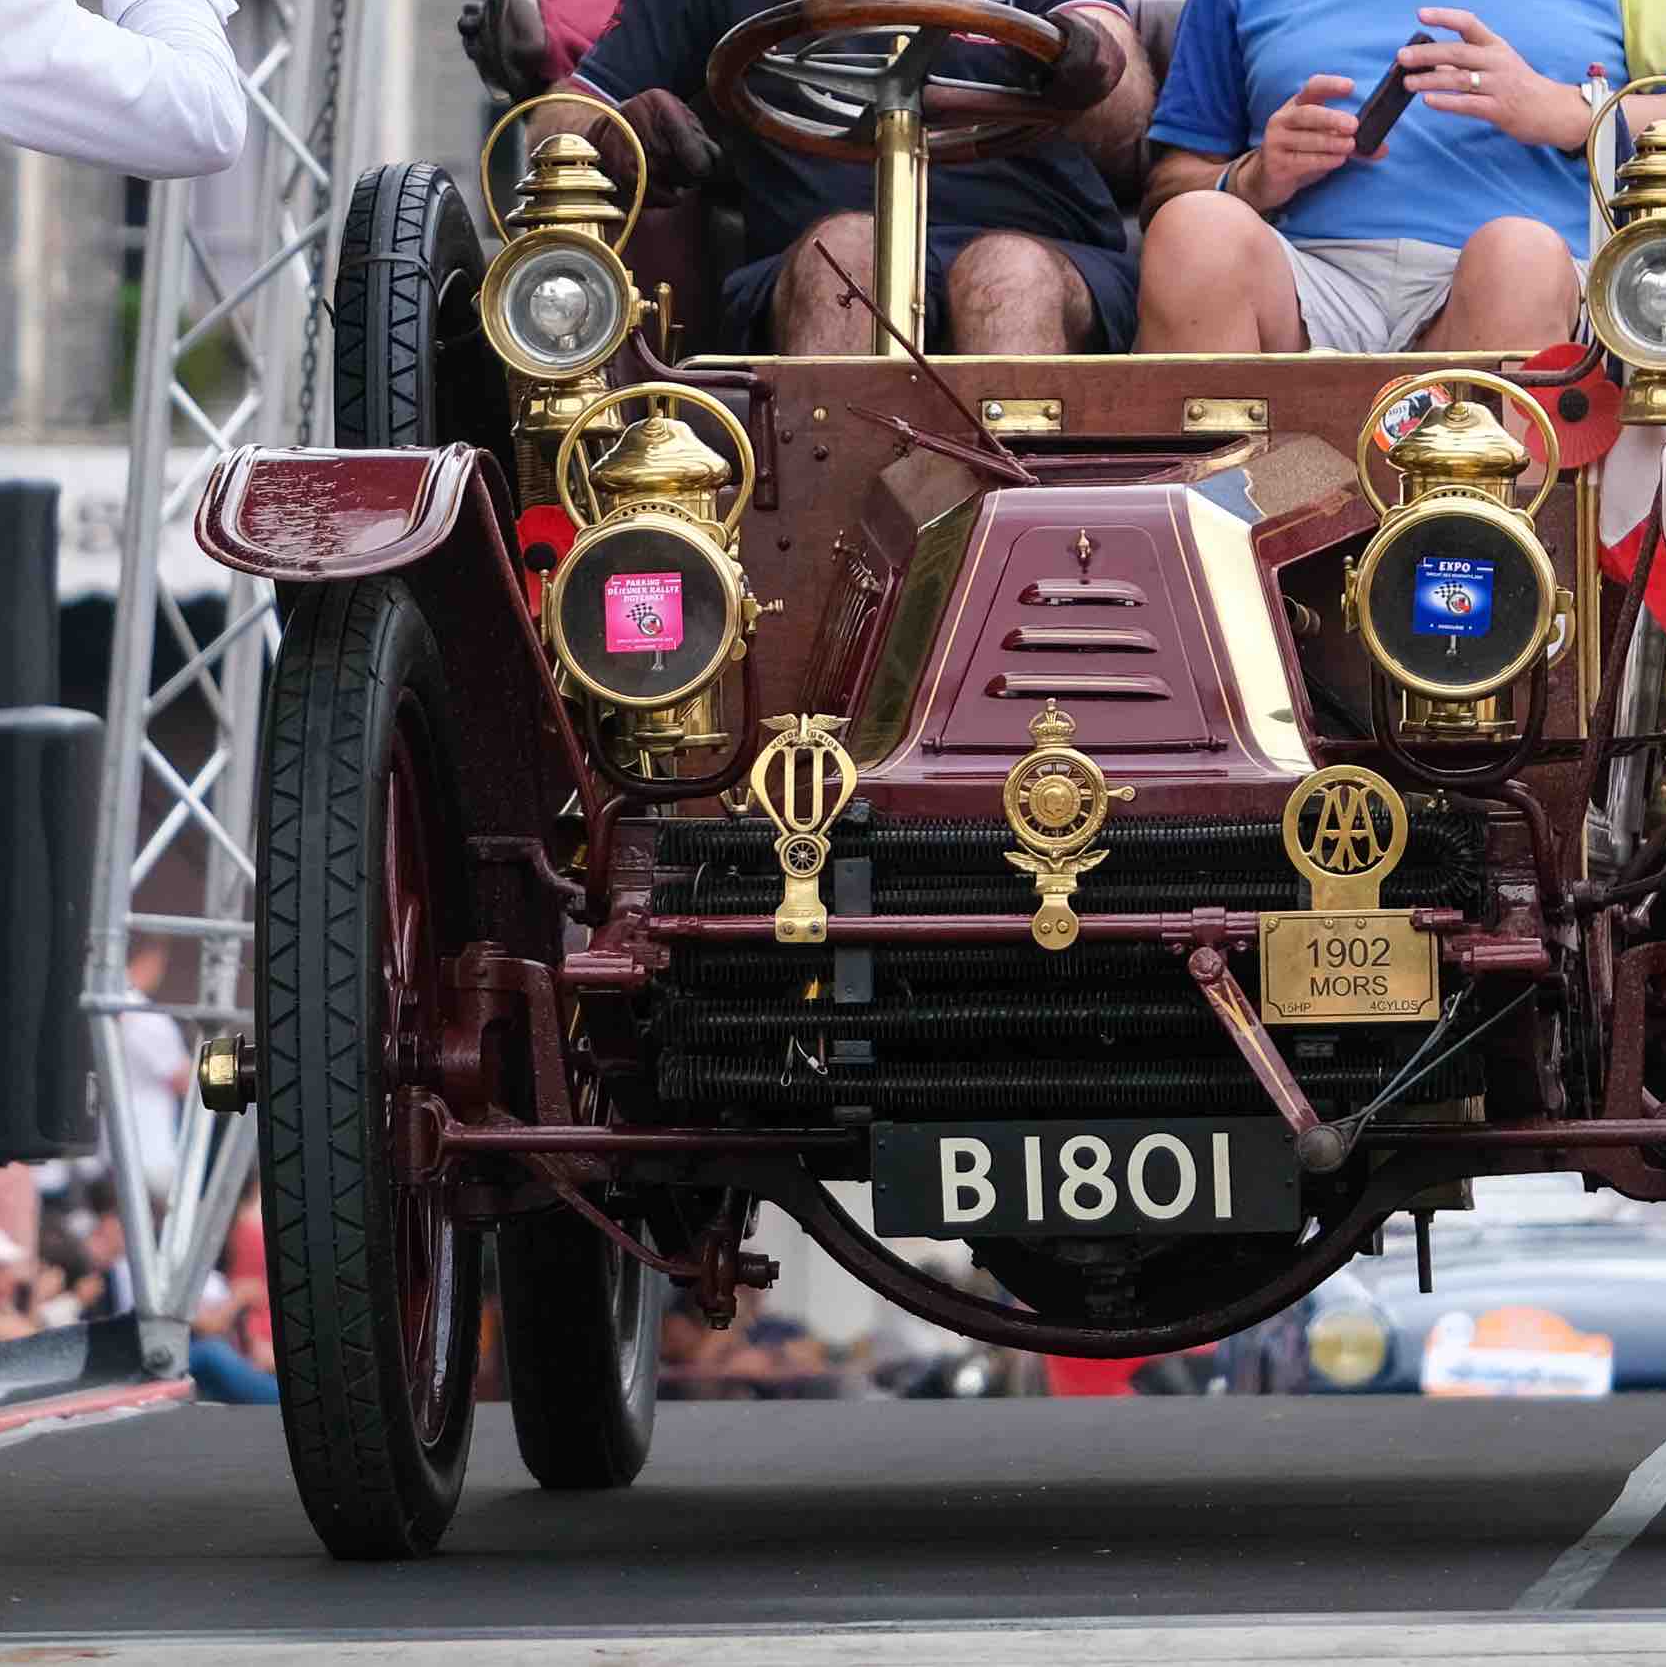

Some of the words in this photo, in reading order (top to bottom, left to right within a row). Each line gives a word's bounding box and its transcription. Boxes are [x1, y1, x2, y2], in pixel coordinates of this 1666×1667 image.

[1438, 560, 1472, 573] EXPO
[625, 578, 661, 587] PARKING
[810, 730, 841, 753] UNION
[1306, 937, 1391, 968] 1902
[1309, 975, 1389, 997] MORS
